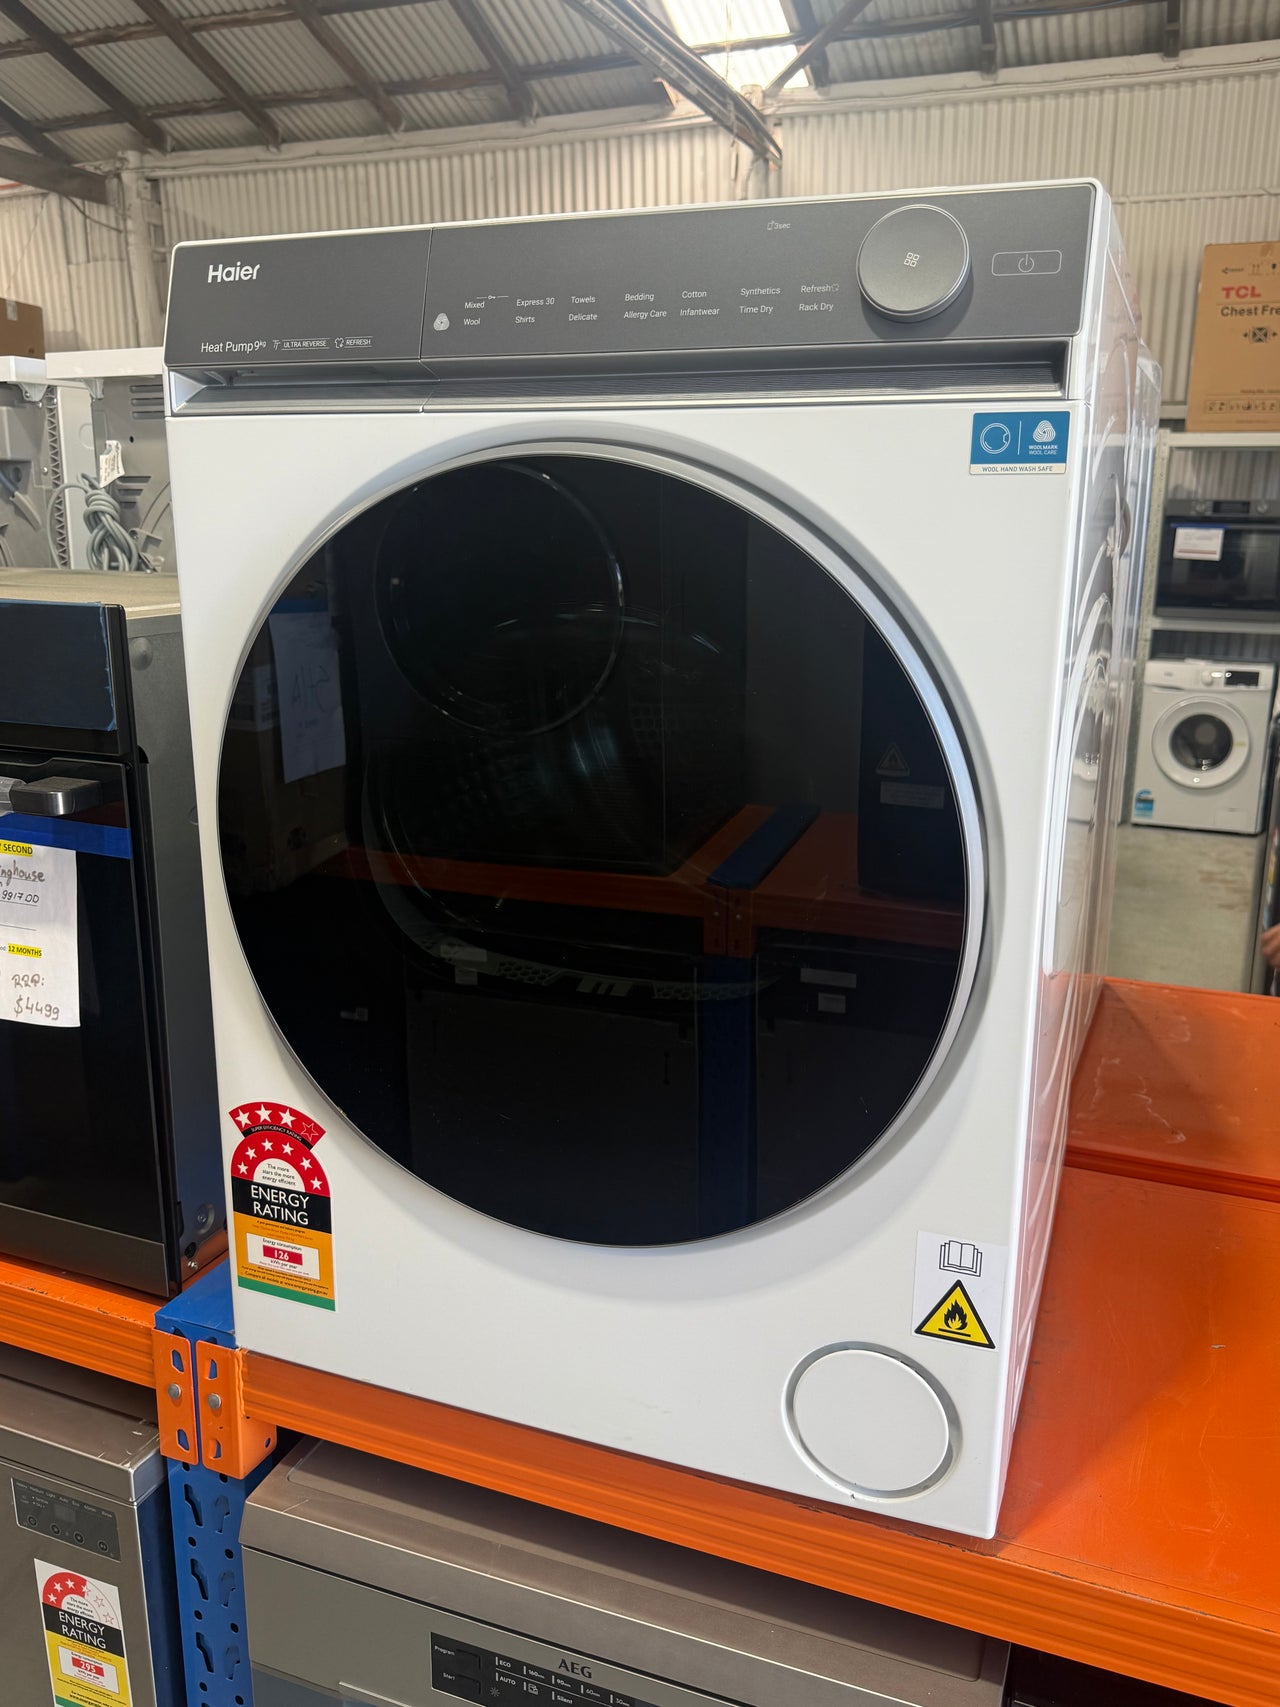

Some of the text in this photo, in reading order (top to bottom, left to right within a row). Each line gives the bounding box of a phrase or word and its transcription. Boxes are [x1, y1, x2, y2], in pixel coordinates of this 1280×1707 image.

[207, 261, 260, 283] Haier
[740, 286, 781, 297] Synthetics
[800, 284, 831, 293] Refresh
[1221, 285, 1262, 299] TCL
[570, 296, 596, 304] Towels
[624, 292, 655, 302] Bedding
[682, 290, 707, 299] Cotton
[464, 301, 485, 309] Mixed
[516, 297, 555, 308] Express 30
[798, 302, 834, 312] Rack Dry
[623, 310, 667, 320] Allergy Care
[680, 308, 720, 316] Infantwear
[739, 305, 774, 314] Time Dry
[1220, 306, 1258, 317] Chest
[463, 317, 481, 326] Wool
[515, 315, 536, 324] Shirts
[568, 312, 598, 322] Delicate
[200, 342, 224, 354] Heat
[226, 340, 254, 354] Pump
[283, 340, 327, 348] ULTRA REVERSE
[346, 338, 372, 346] REFRESH
[3, 843, 33, 855] SECOND
[16, 946, 42, 956] MONTHS
[14, 994, 60, 1020] $4499
[286, 1130, 302, 1141] RATING
[262, 1175, 297, 1186] energy efficient
[250, 1184, 310, 1209] ENERGY
[253, 1201, 309, 1225] RATING
[274, 1250, 290, 1261] 126
[58, 1611, 105, 1636] ENERGY
[62, 1624, 106, 1649] RATING
[434, 1645, 455, 1656] Program
[80, 1661, 96, 1674] 295
[499, 1660, 512, 1668] ECO
[558, 1658, 593, 1679] AEG
[442, 1672, 456, 1681] Start
[499, 1676, 516, 1686] AUTO
[556, 1694, 573, 1705] Silent
